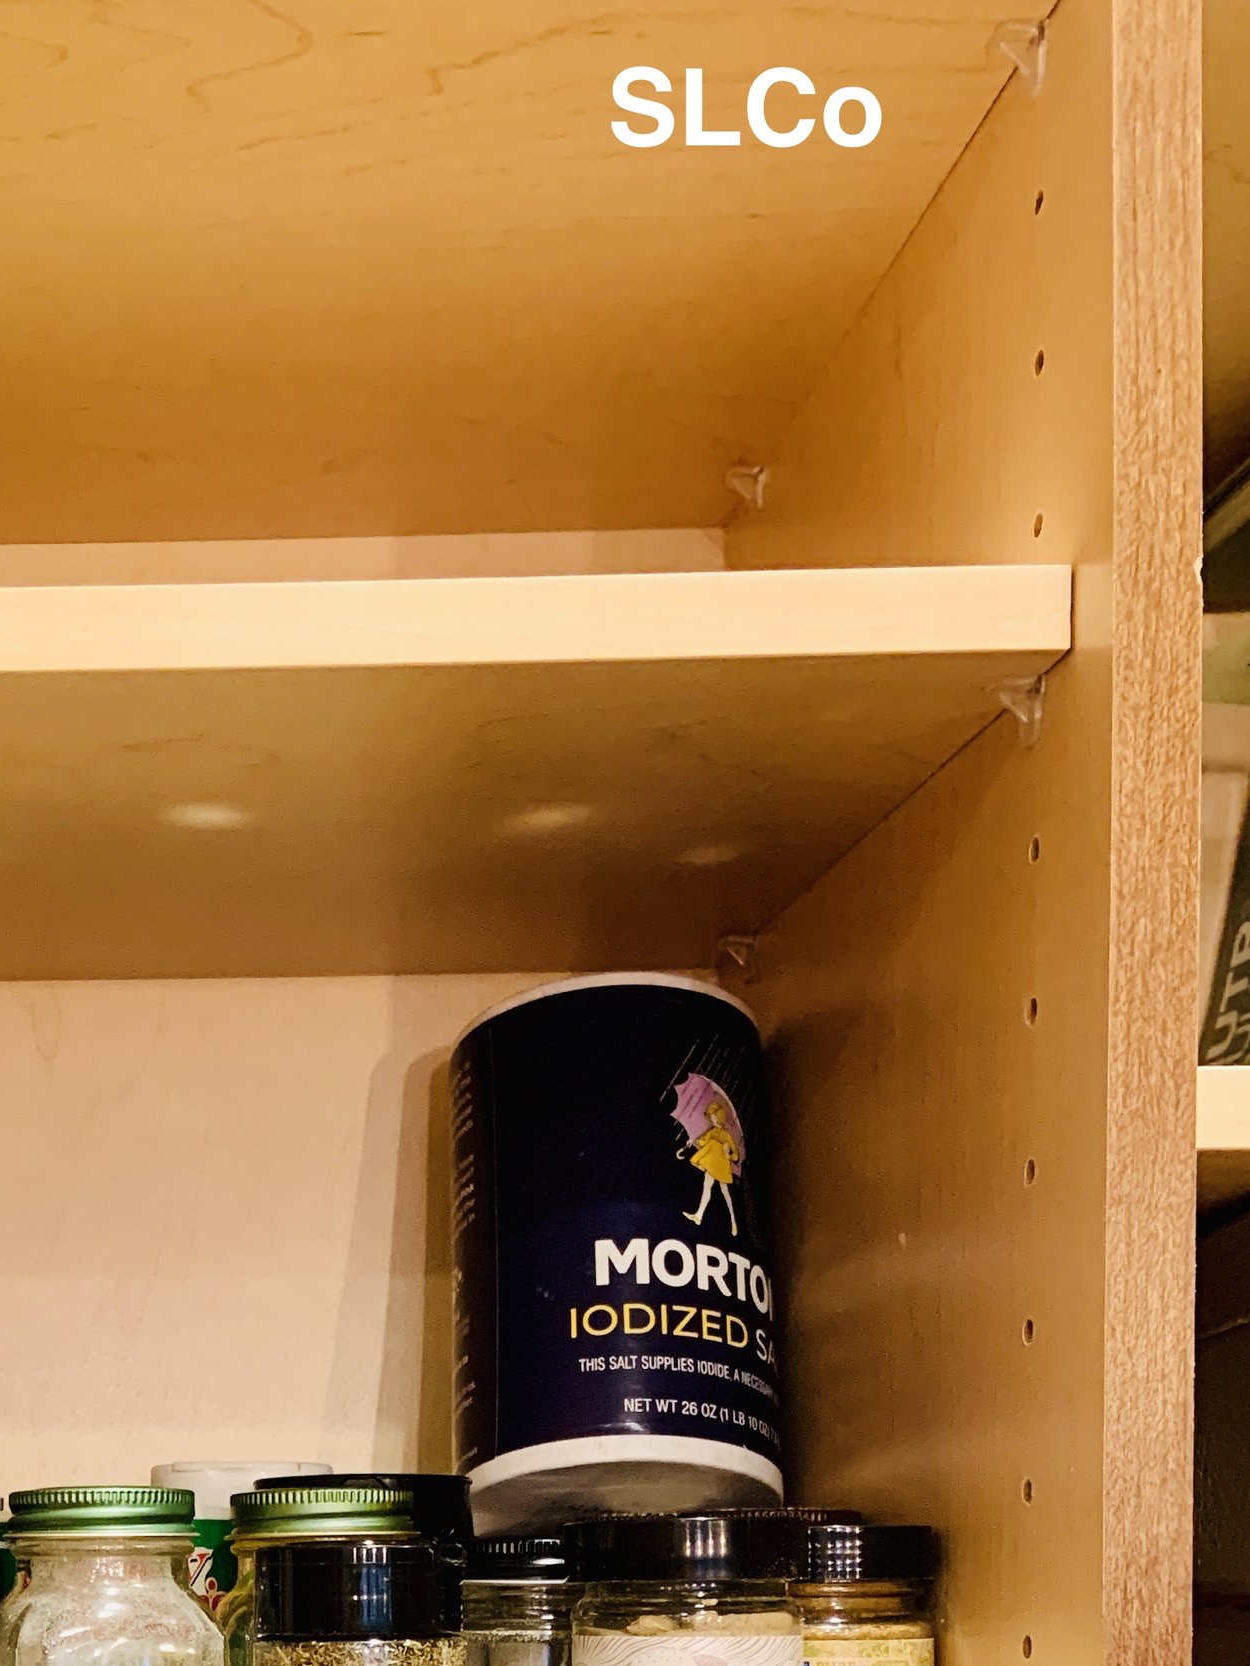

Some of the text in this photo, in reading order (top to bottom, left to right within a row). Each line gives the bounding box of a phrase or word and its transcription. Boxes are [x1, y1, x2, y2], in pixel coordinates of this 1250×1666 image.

[570, 1302, 749, 1350] IODIZED
[579, 1355, 740, 1381] THIS SALT SUPPLIES IODIDE, A
[681, 1401, 746, 1426] 26 (1 LB
